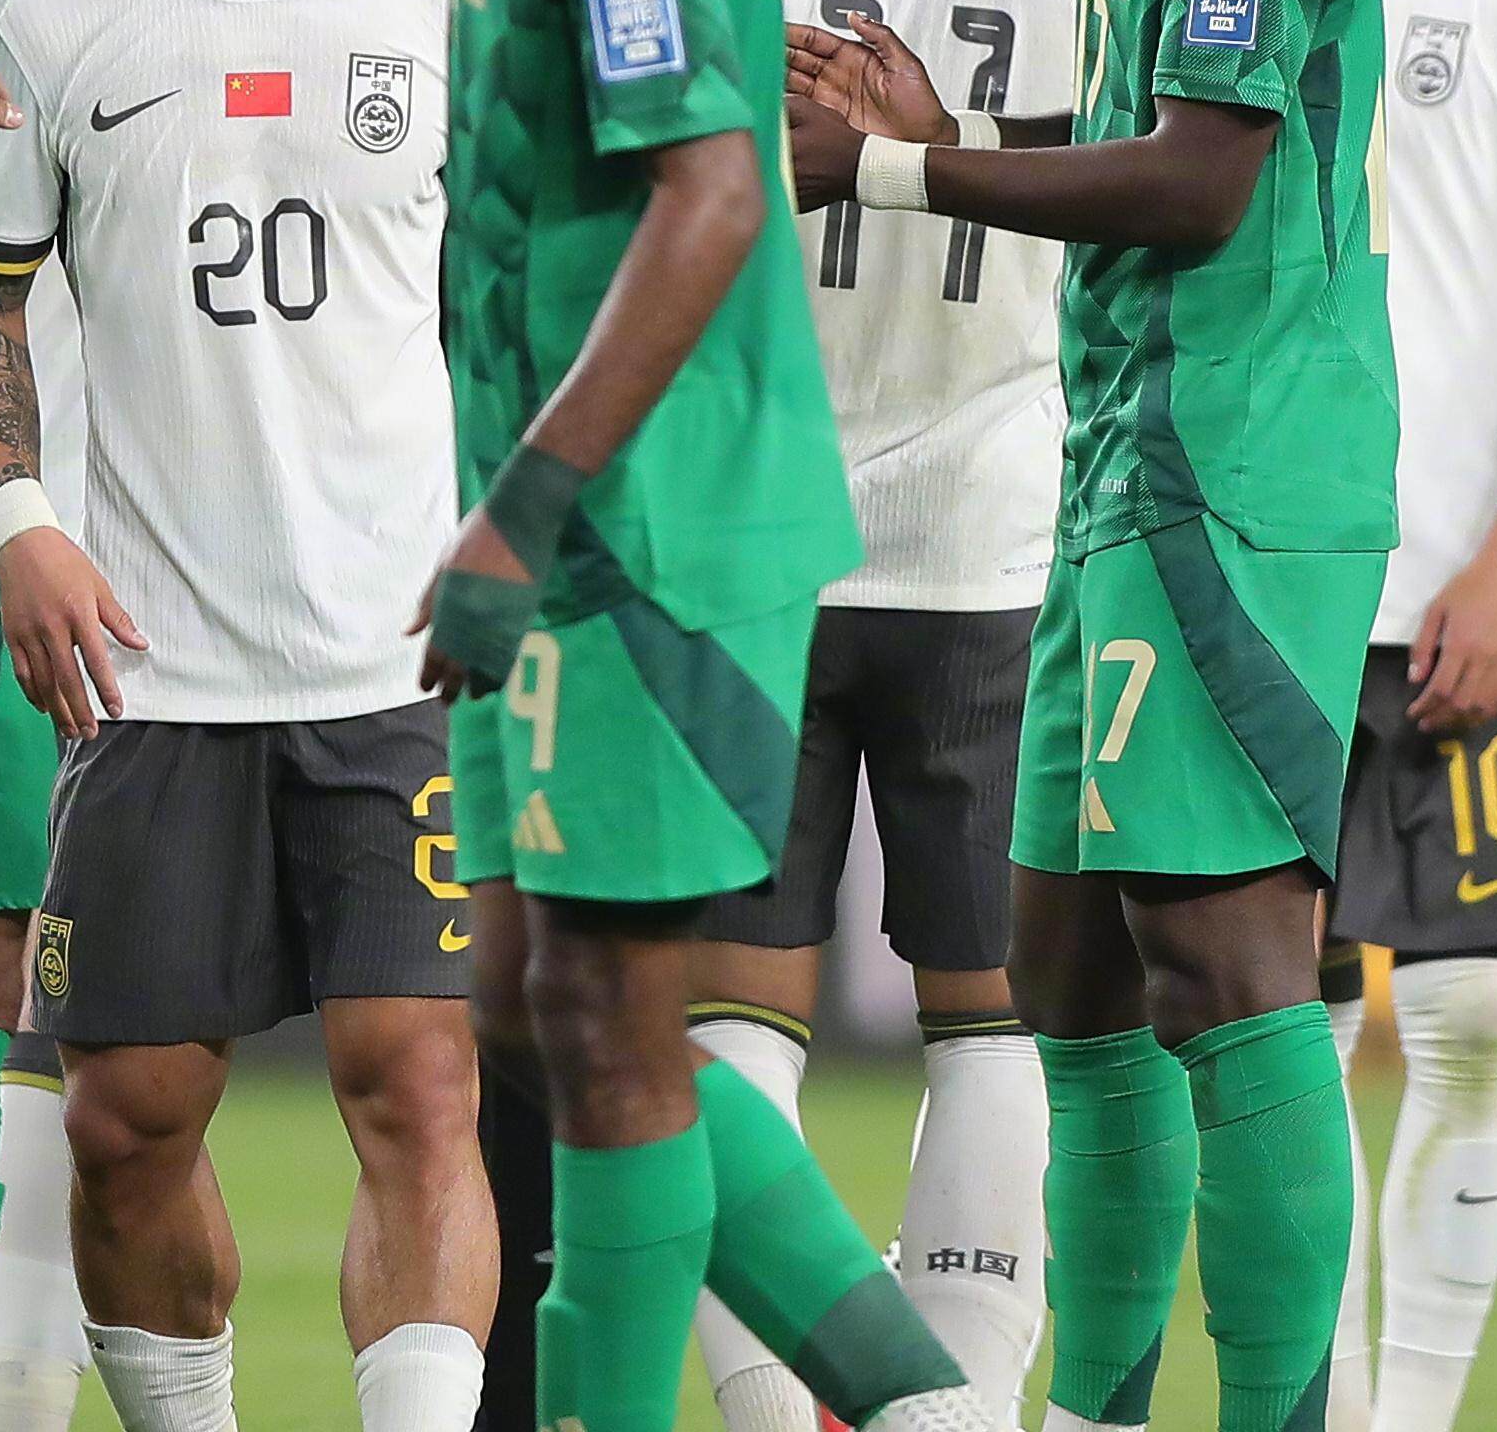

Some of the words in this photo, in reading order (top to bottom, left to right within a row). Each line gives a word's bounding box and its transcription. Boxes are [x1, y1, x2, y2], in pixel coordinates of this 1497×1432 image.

[1213, 20, 1230, 28] FIFA
[355, 60, 407, 81] CFA
[188, 197, 328, 327] 20
[42, 919, 68, 938] CFA
[927, 1247, 1019, 1282] 中国
